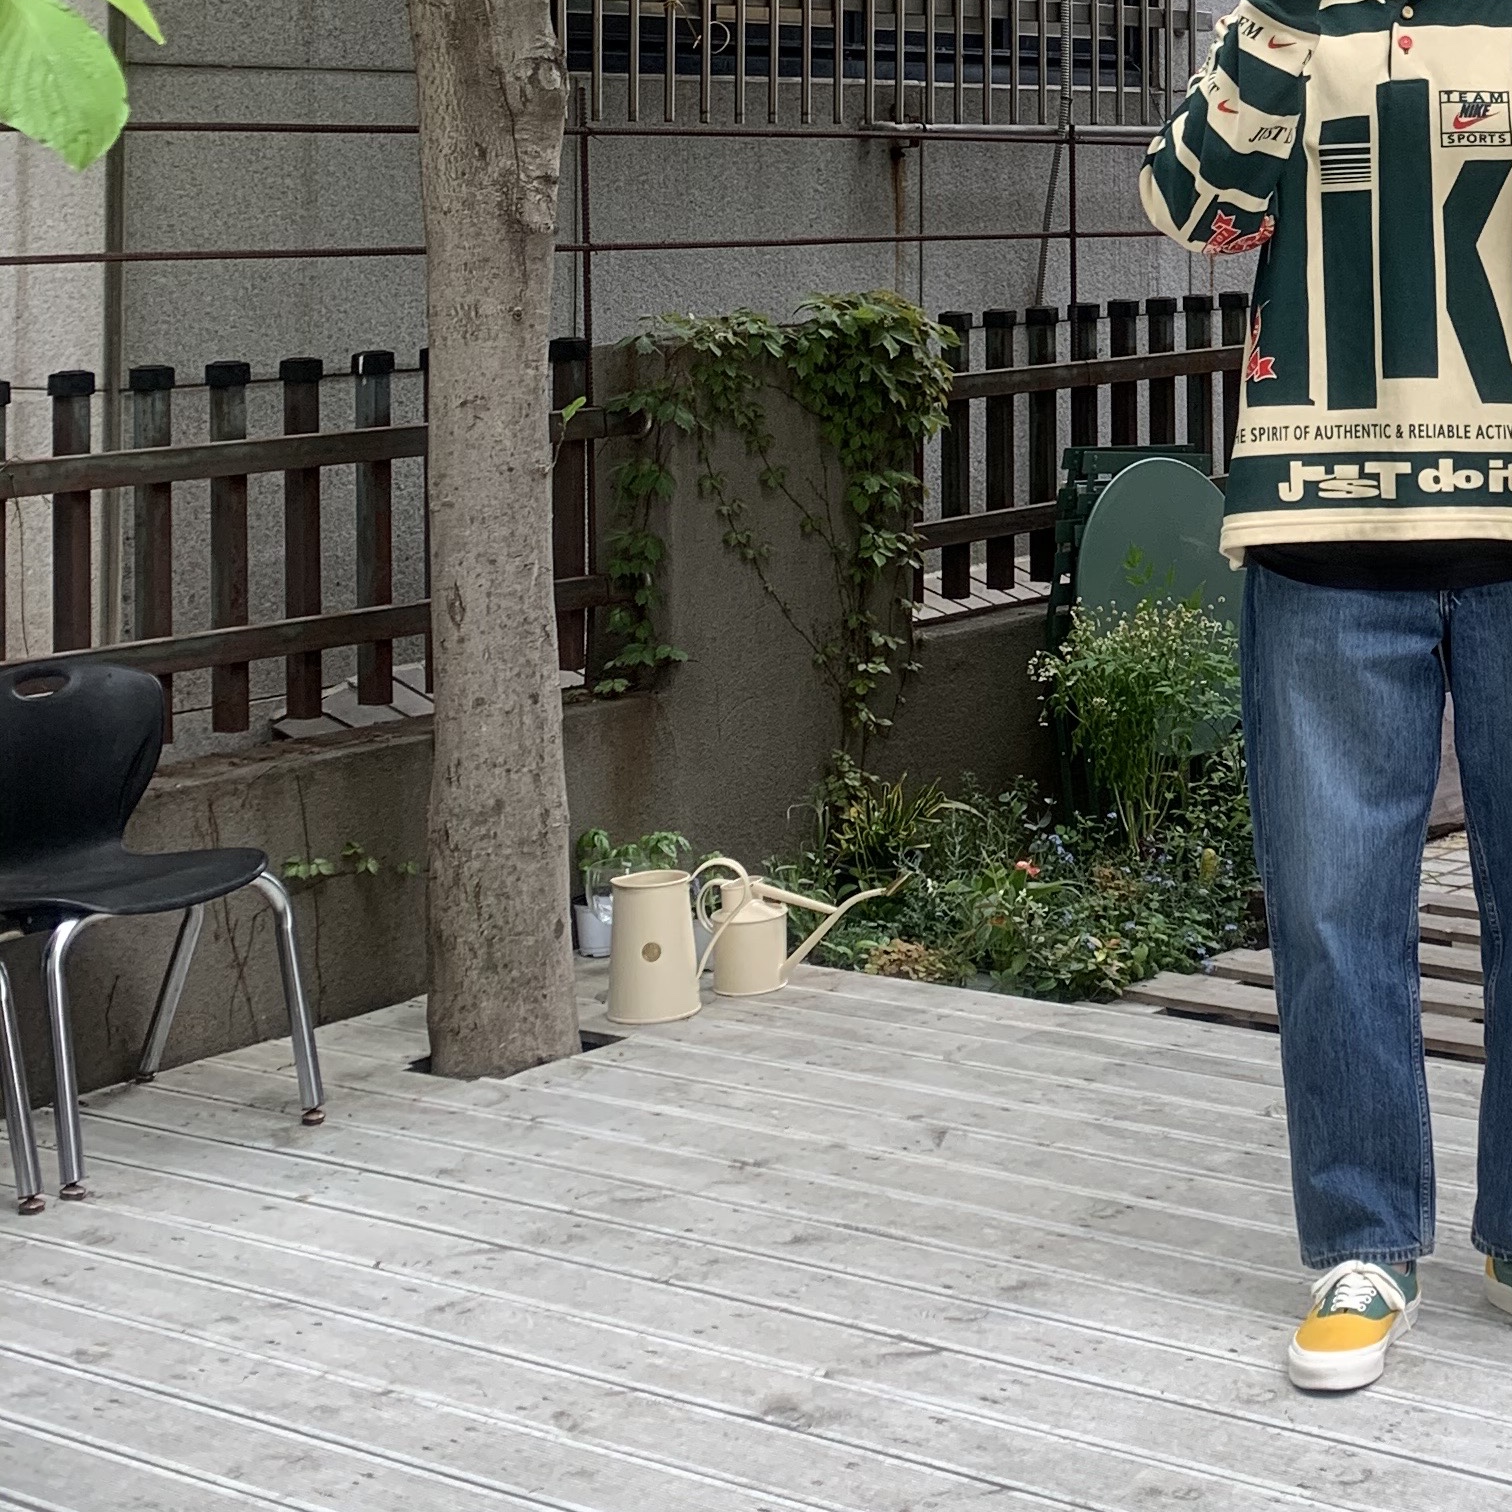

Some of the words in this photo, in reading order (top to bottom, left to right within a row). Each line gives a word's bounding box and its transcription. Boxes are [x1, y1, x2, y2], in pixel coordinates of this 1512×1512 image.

[1444, 92, 1503, 103] TEAM
[1459, 102, 1491, 118] NIKE
[1447, 133, 1506, 144] SPORTS
[1250, 425, 1290, 443] SPIRIT
[1293, 425, 1310, 441] OF
[1314, 423, 1392, 440] AUTHENTIC
[1395, 423, 1404, 439] &
[1408, 423, 1471, 439] RELIABLE
